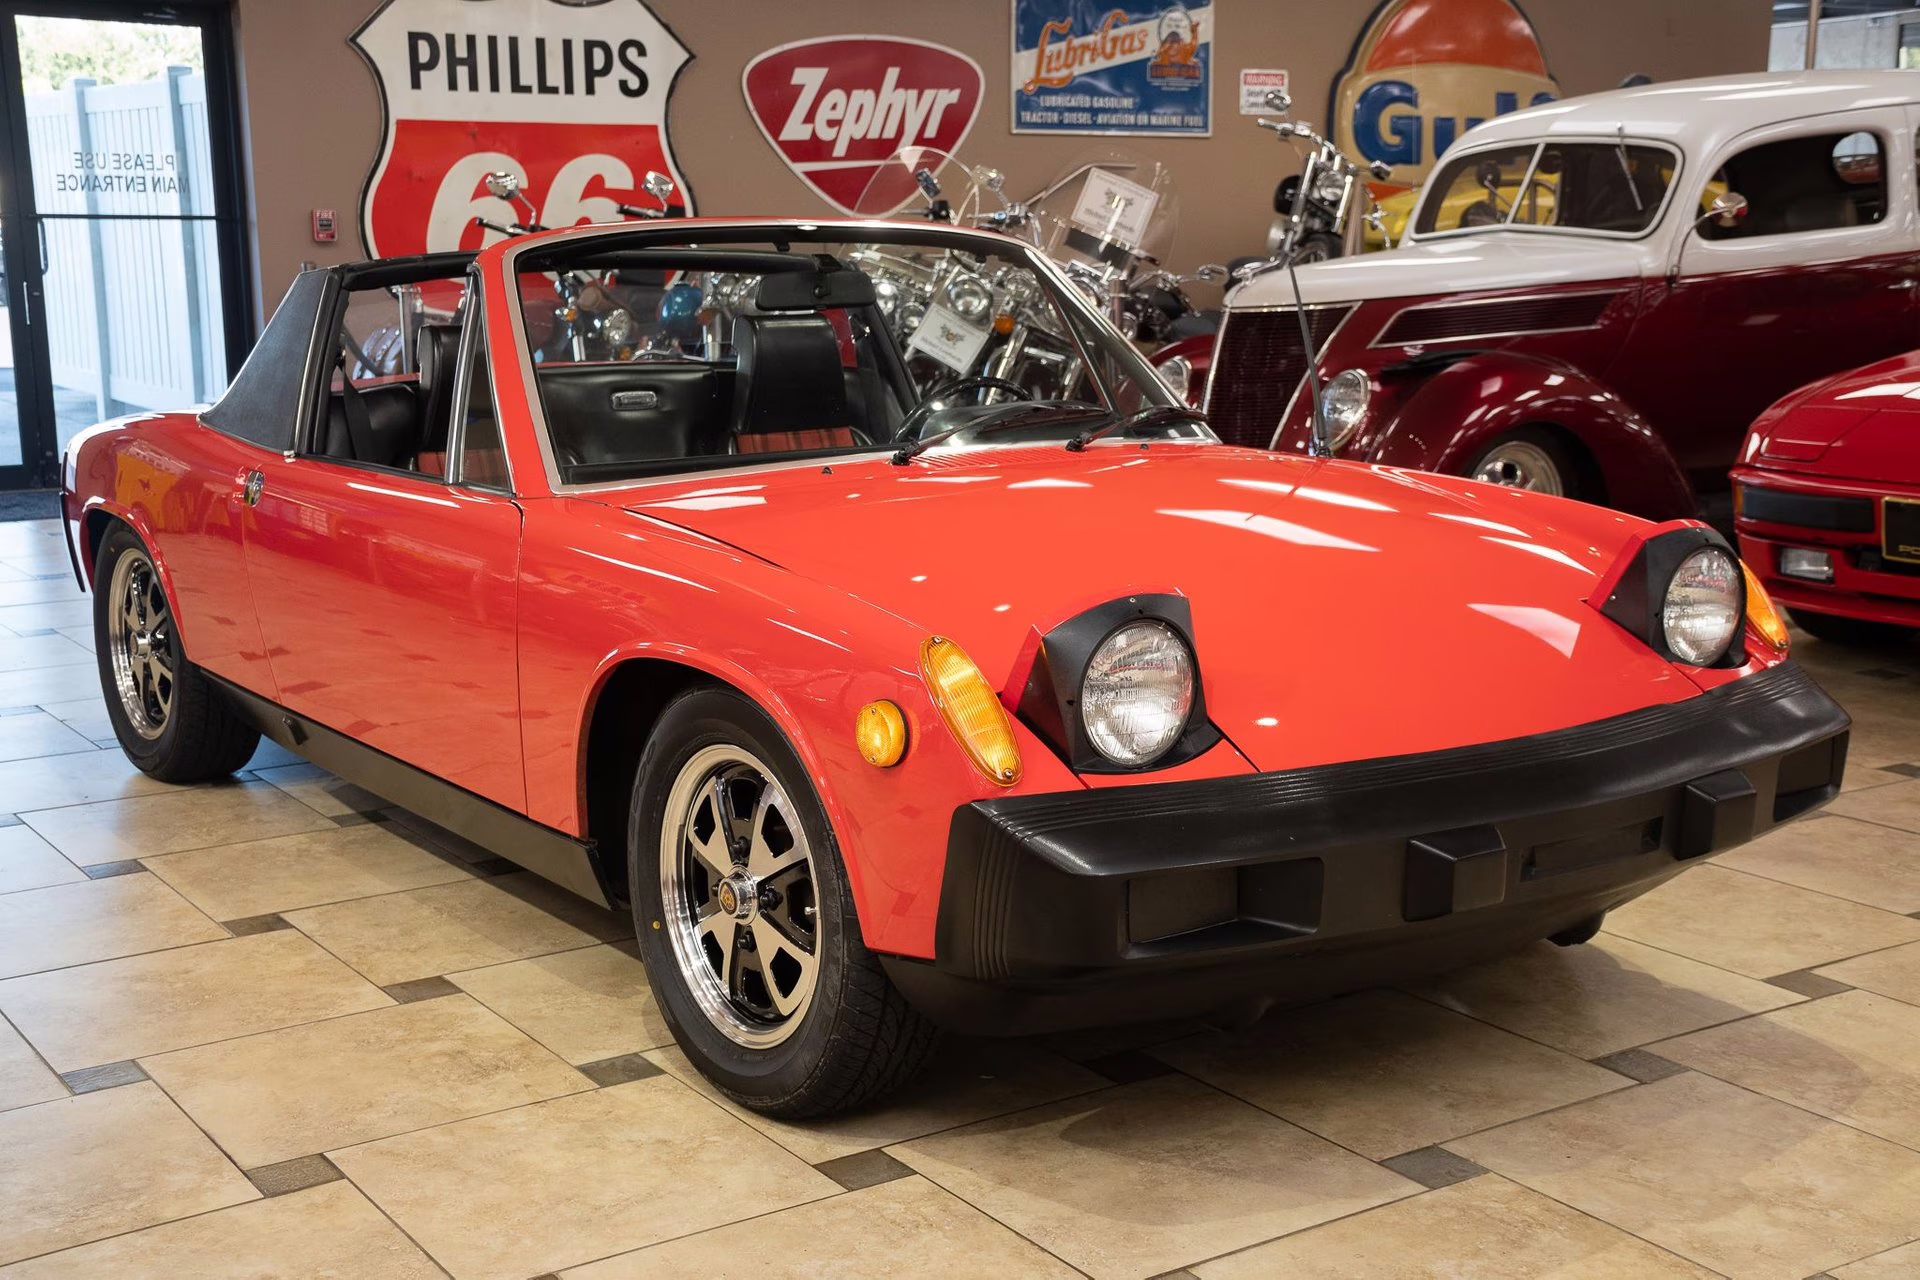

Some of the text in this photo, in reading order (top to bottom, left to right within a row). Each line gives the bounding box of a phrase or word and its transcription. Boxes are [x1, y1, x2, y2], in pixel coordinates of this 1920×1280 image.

[407, 31, 649, 98] PHILLIPS
[778, 67, 961, 157] Zephyr
[1021, 111, 1204, 127] TRACTOR DIESEL AVIATION OR MARINE FUEL
[1040, 95, 1134, 109] LUBRICATED GASOLINE
